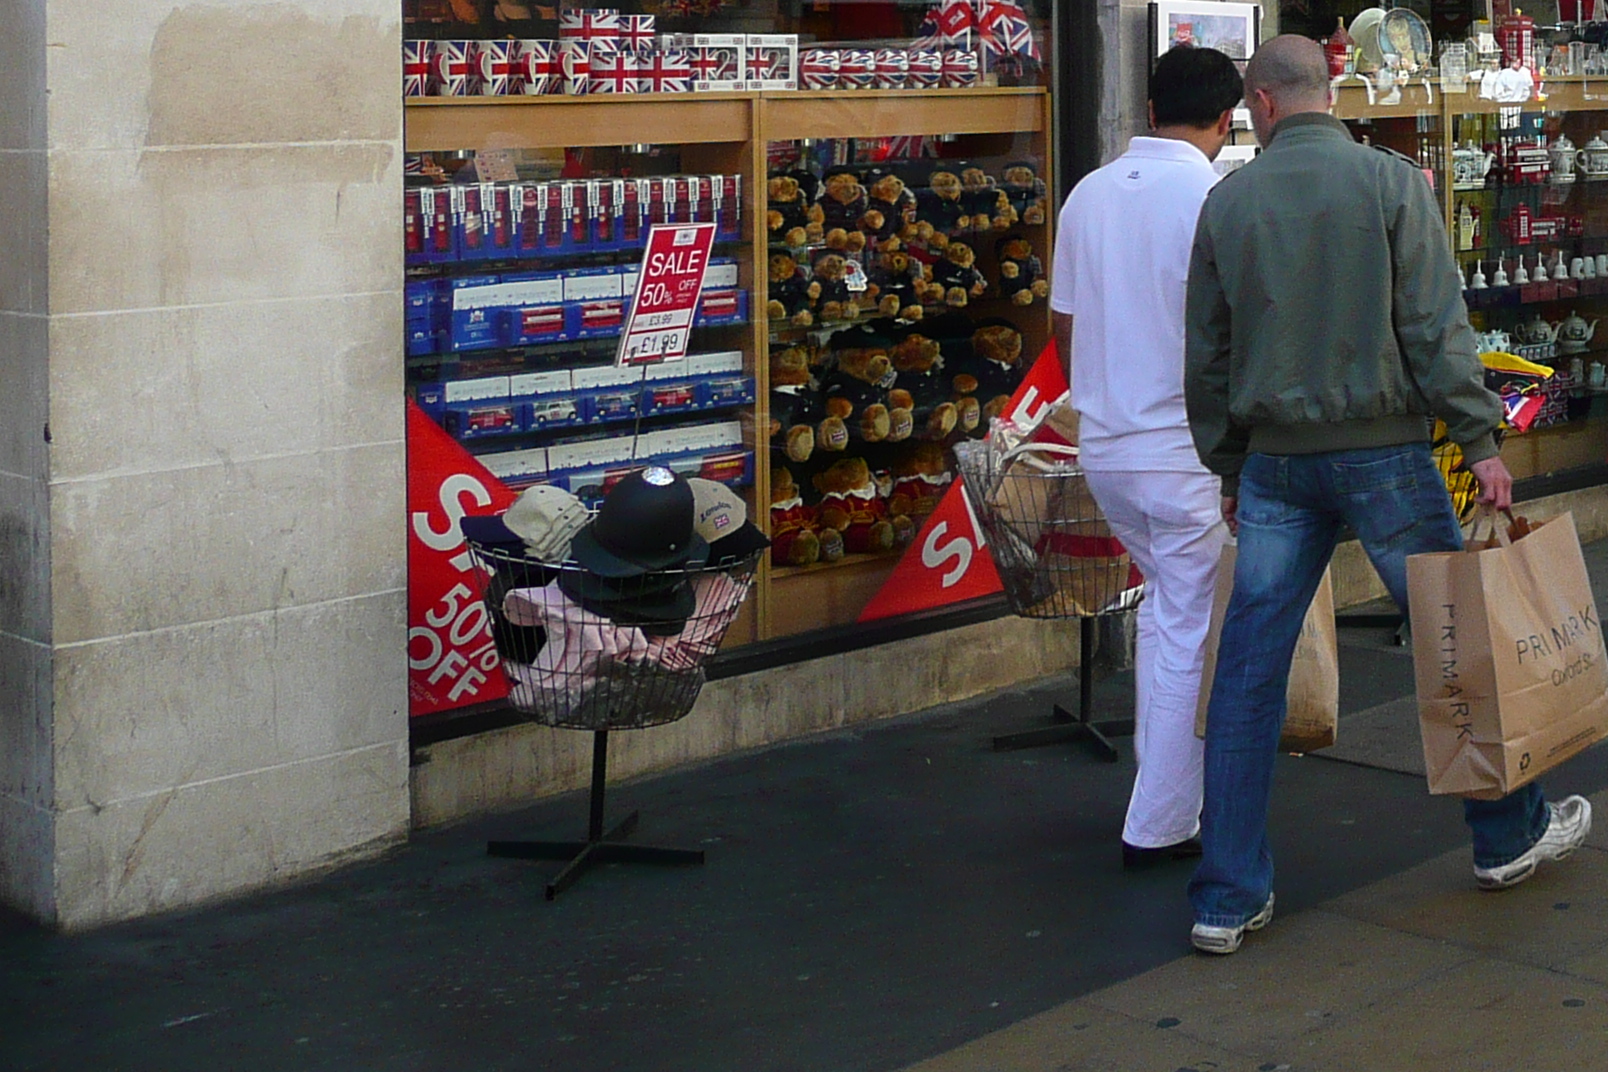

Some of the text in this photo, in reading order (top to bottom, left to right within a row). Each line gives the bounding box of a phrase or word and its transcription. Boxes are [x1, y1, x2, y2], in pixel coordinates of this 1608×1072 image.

[649, 250, 703, 277] SALE
[640, 282, 673, 307] 50%
[678, 278, 698, 291] OFF
[640, 333, 679, 354] £1.99
[408, 627, 487, 703] OFF
[1440, 603, 1475, 742] PRIMARK
